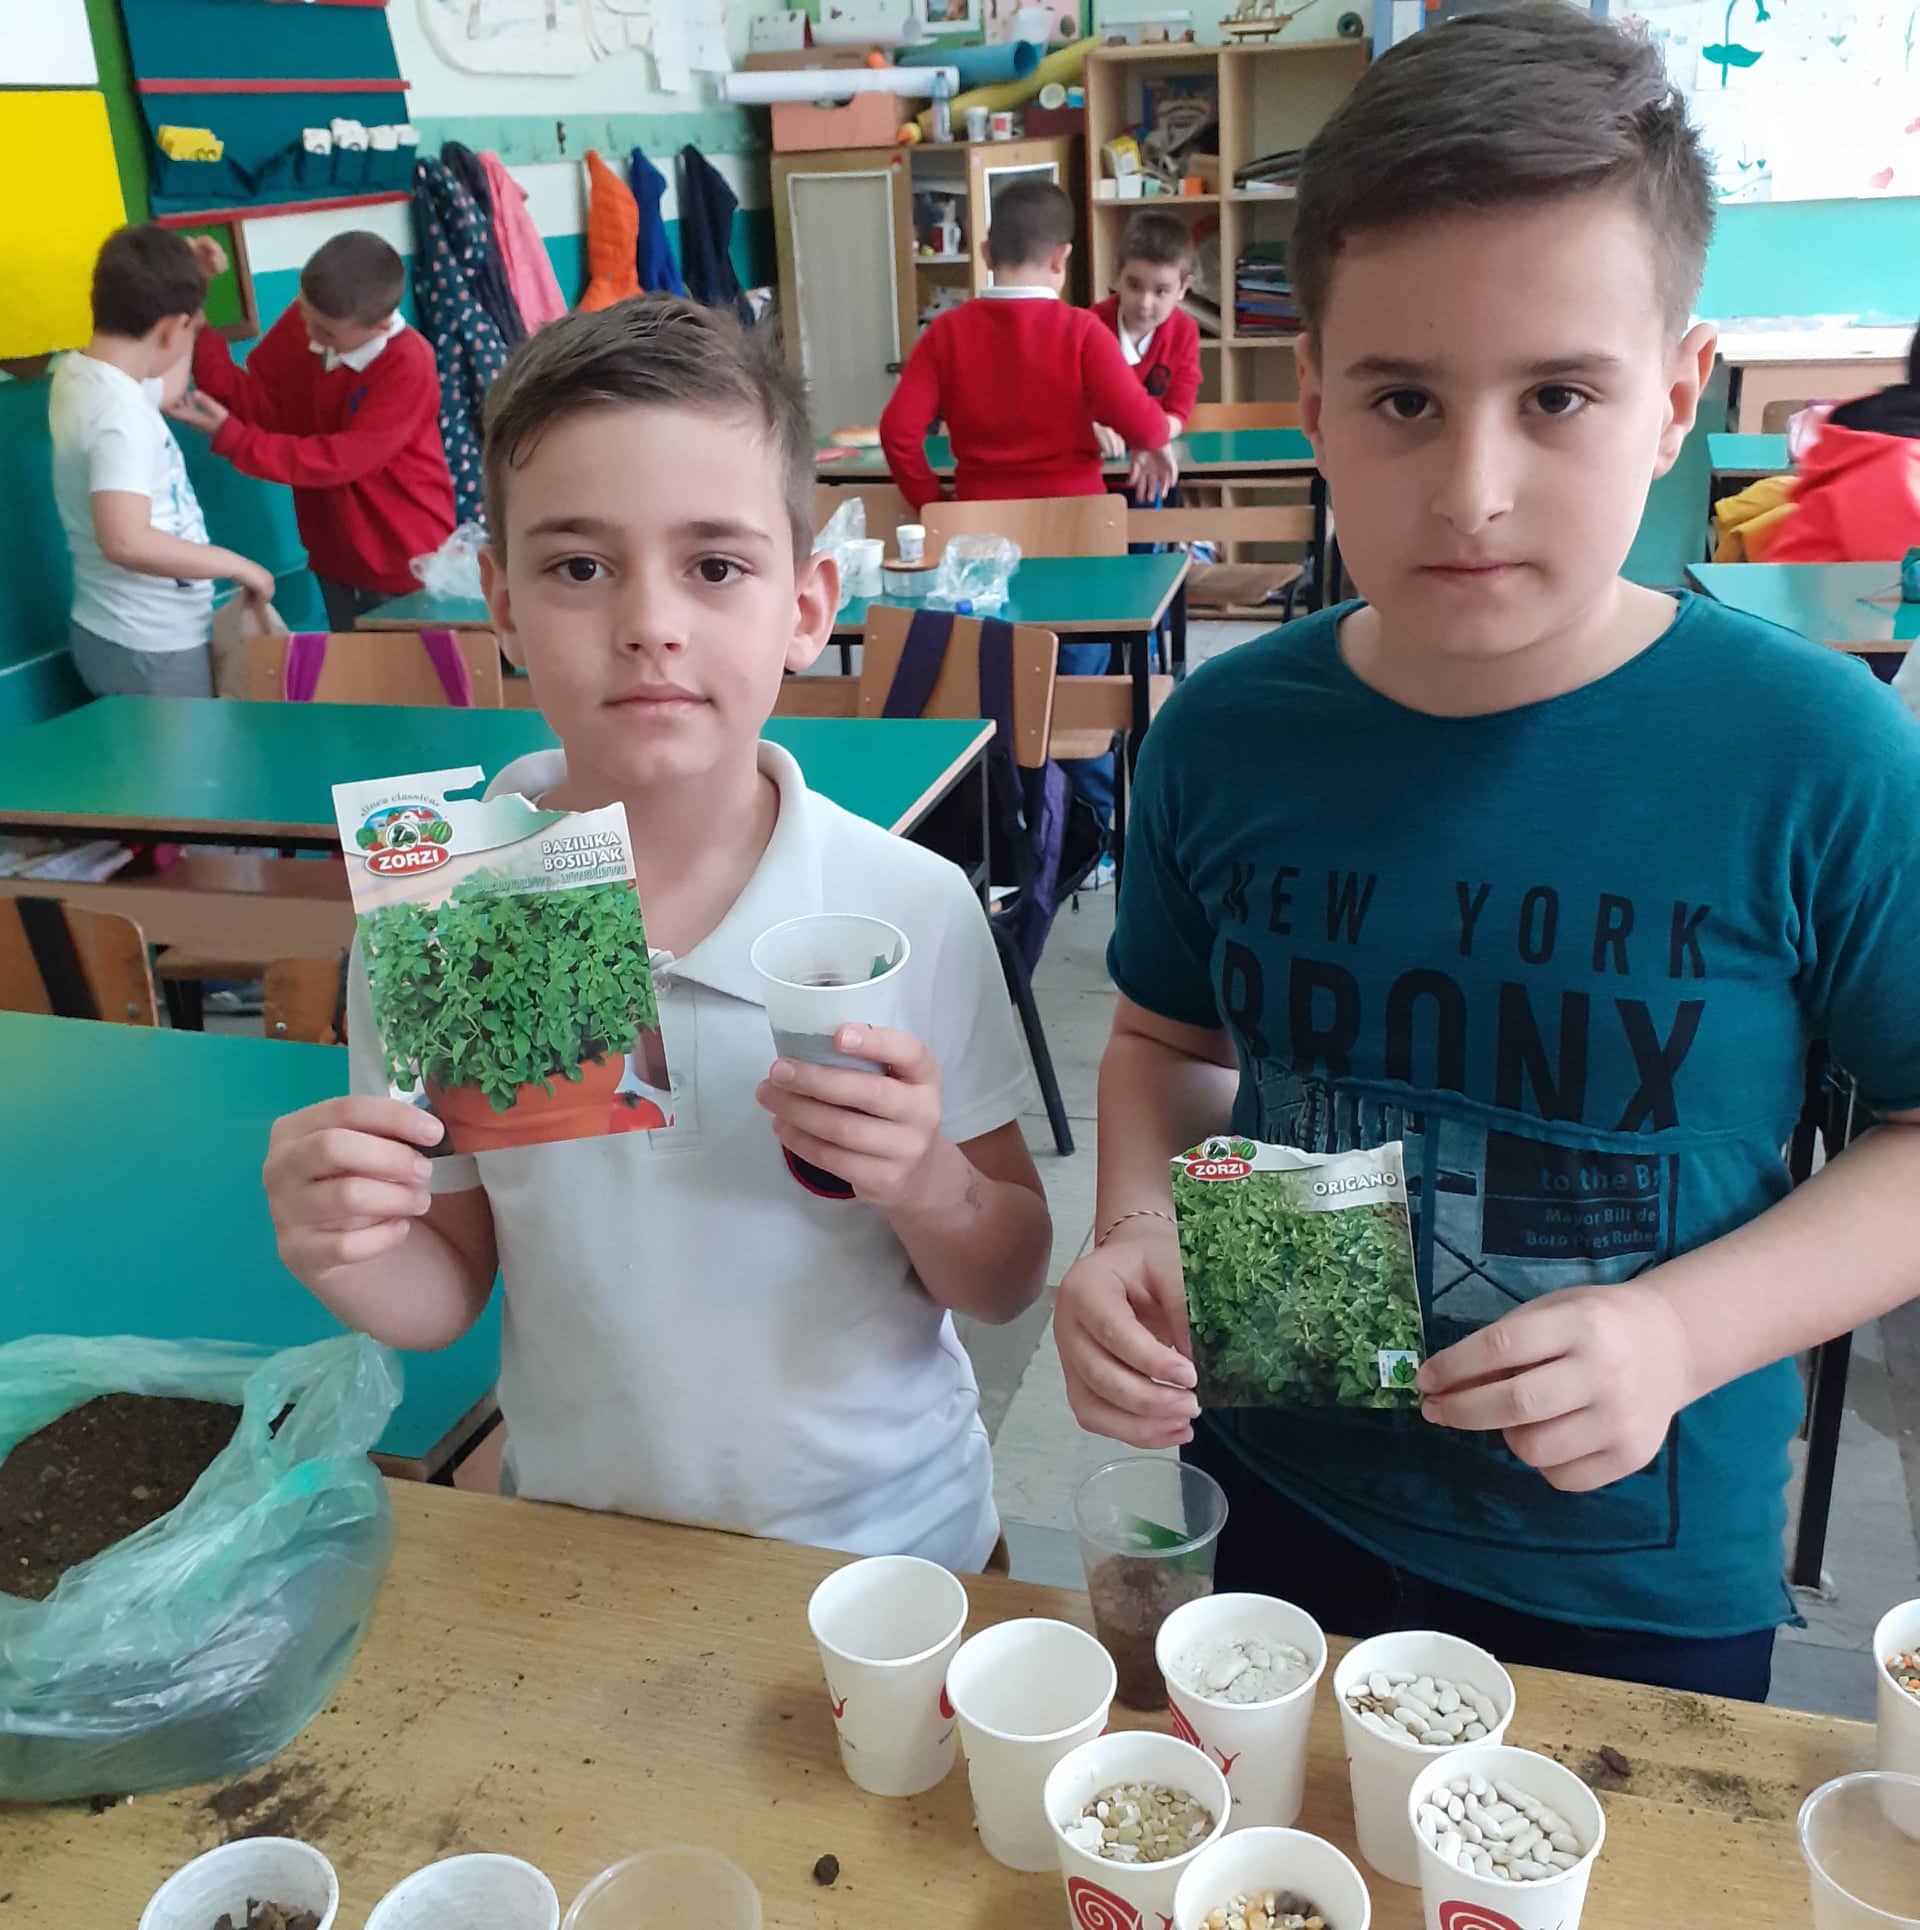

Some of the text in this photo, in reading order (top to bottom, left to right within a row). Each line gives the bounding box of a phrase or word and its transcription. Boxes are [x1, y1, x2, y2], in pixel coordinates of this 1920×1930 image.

[541, 831, 622, 854] BAZILIKA
[378, 849, 440, 871] ZORZI
[543, 848, 625, 871] BOSILJAK
[1455, 880, 1711, 979] YORK
[1194, 1163, 1245, 1177] ZORZI
[1540, 1168, 1570, 1191] to
[1577, 1166, 1628, 1192] the
[1313, 1172, 1399, 1196] ORIGANO
[1637, 1206, 1657, 1223] de
